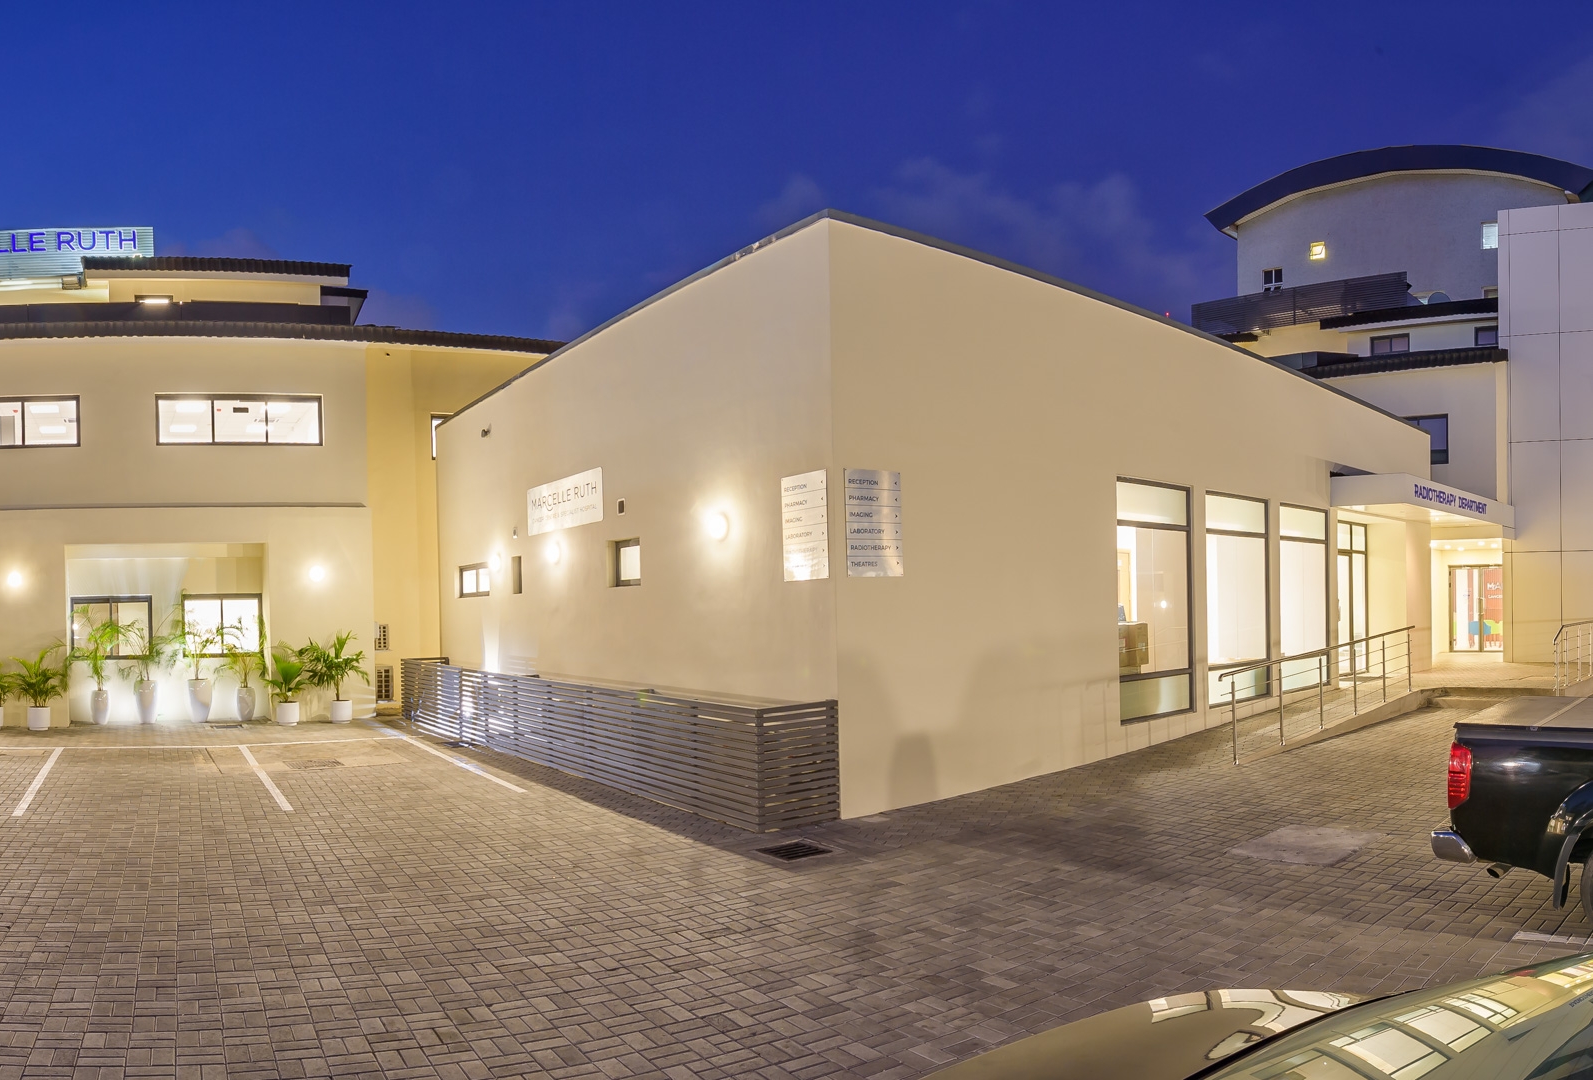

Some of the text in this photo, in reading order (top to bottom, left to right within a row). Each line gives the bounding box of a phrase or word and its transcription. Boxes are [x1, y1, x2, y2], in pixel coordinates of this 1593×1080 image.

[57, 230, 138, 251] RUTH
[848, 478, 879, 486] RECEPTION
[784, 483, 807, 493] RECEPTION
[531, 481, 597, 512] MARCELLE RUTH
[1414, 483, 1487, 515] RADIOTHERAPY DEPARTMENT
[784, 499, 808, 508] PHARMACY
[785, 516, 803, 524] IMAGING
[785, 531, 813, 540] LABORATORY
